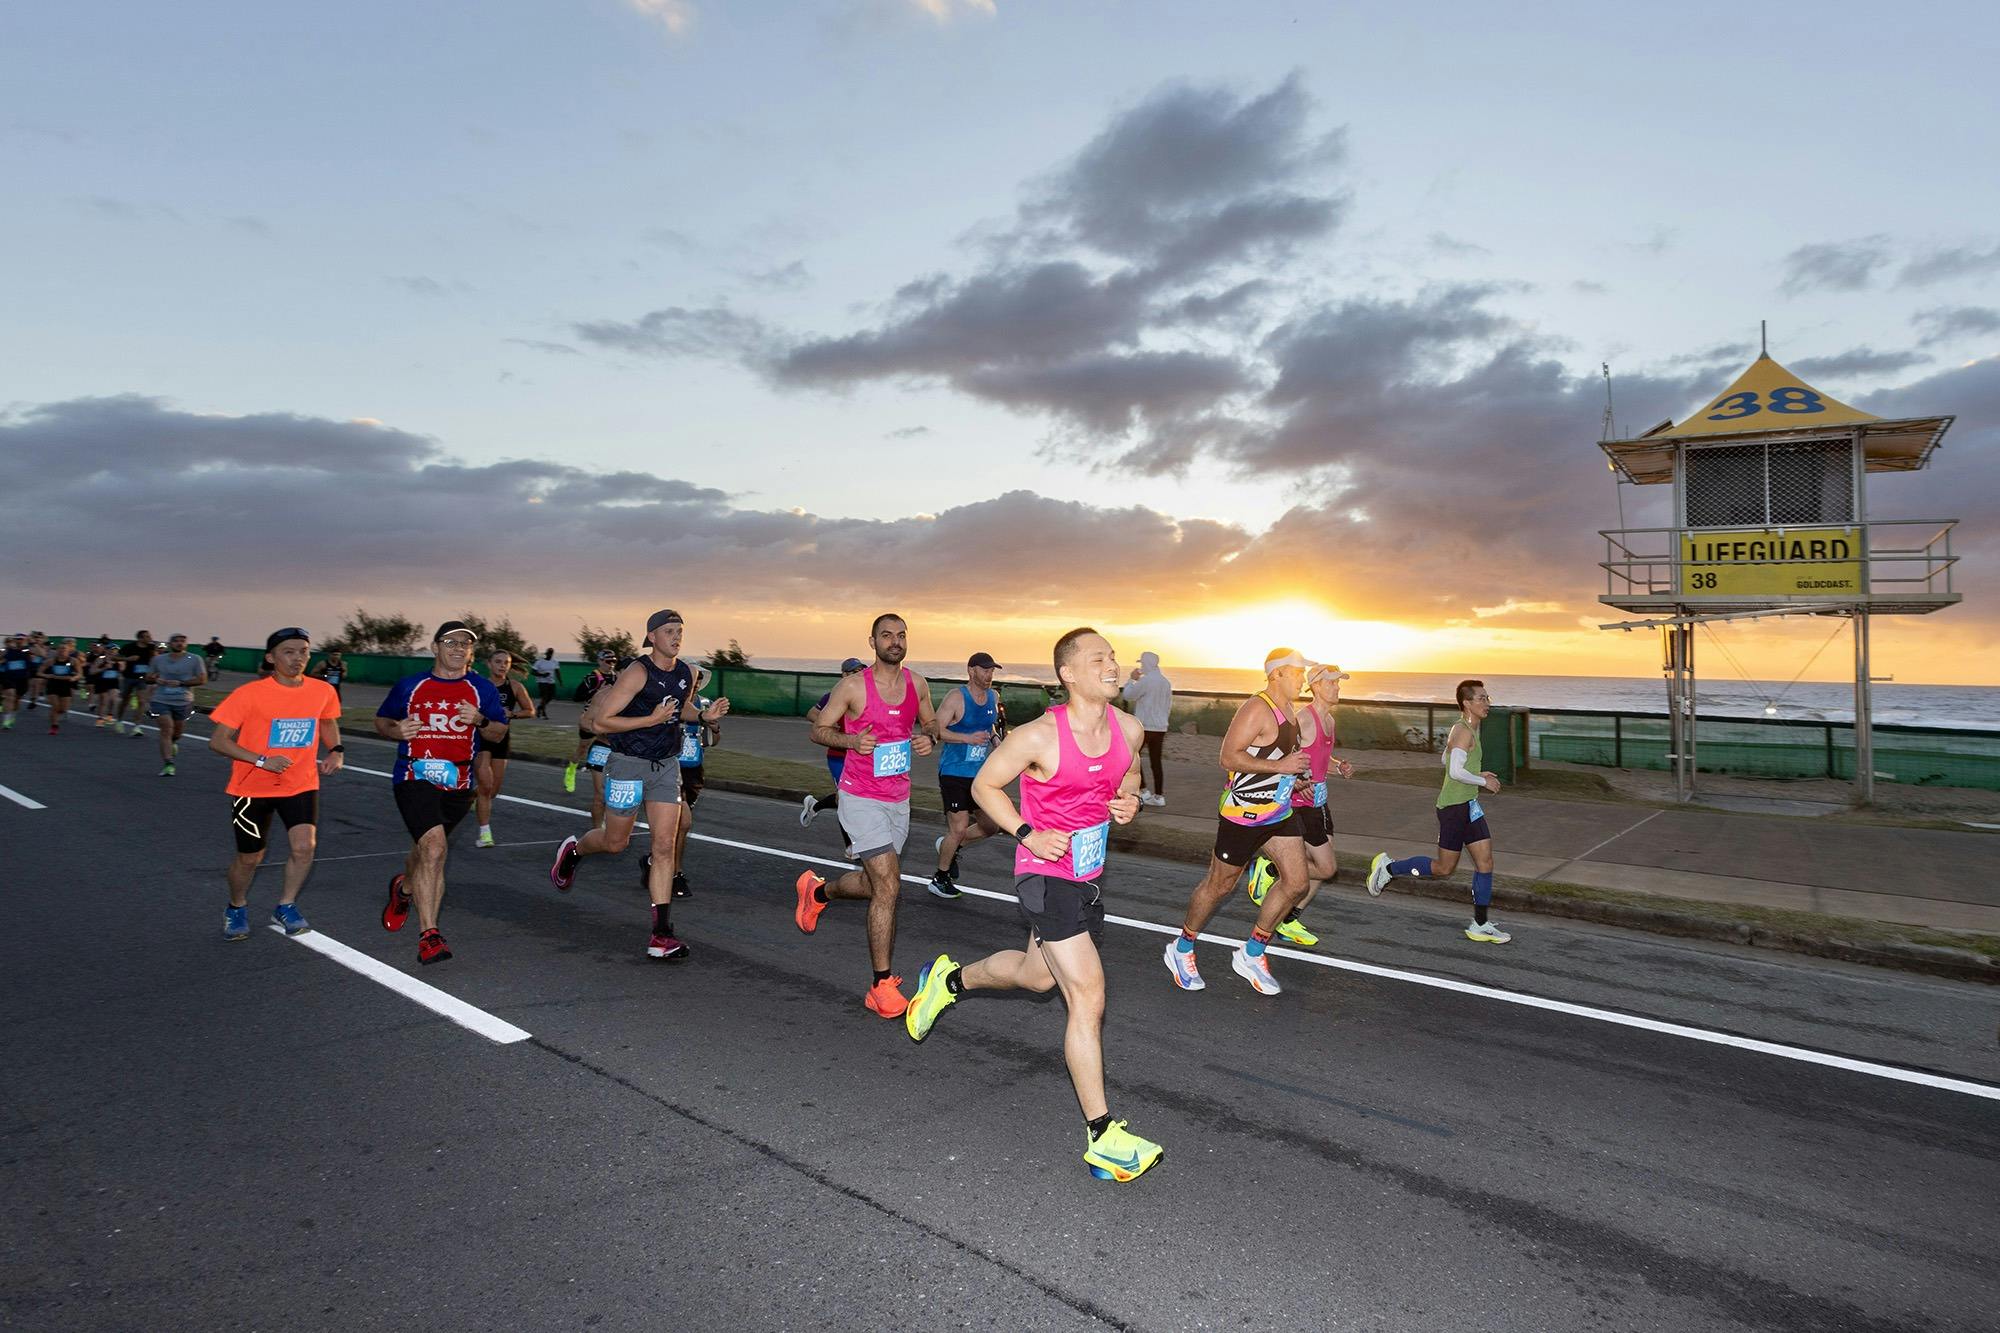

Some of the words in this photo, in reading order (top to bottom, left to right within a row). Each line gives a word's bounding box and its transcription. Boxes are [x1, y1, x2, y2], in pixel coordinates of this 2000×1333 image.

[1708, 387, 1826, 421] 38
[1691, 539, 1850, 566] LIFEGUARD
[1691, 572, 1717, 589] 38
[279, 728, 309, 743] 1767
[424, 762, 446, 770] CHRIS
[879, 751, 907, 771] 2325
[608, 789, 635, 804] 3973
[1079, 838, 1103, 868] 2323
